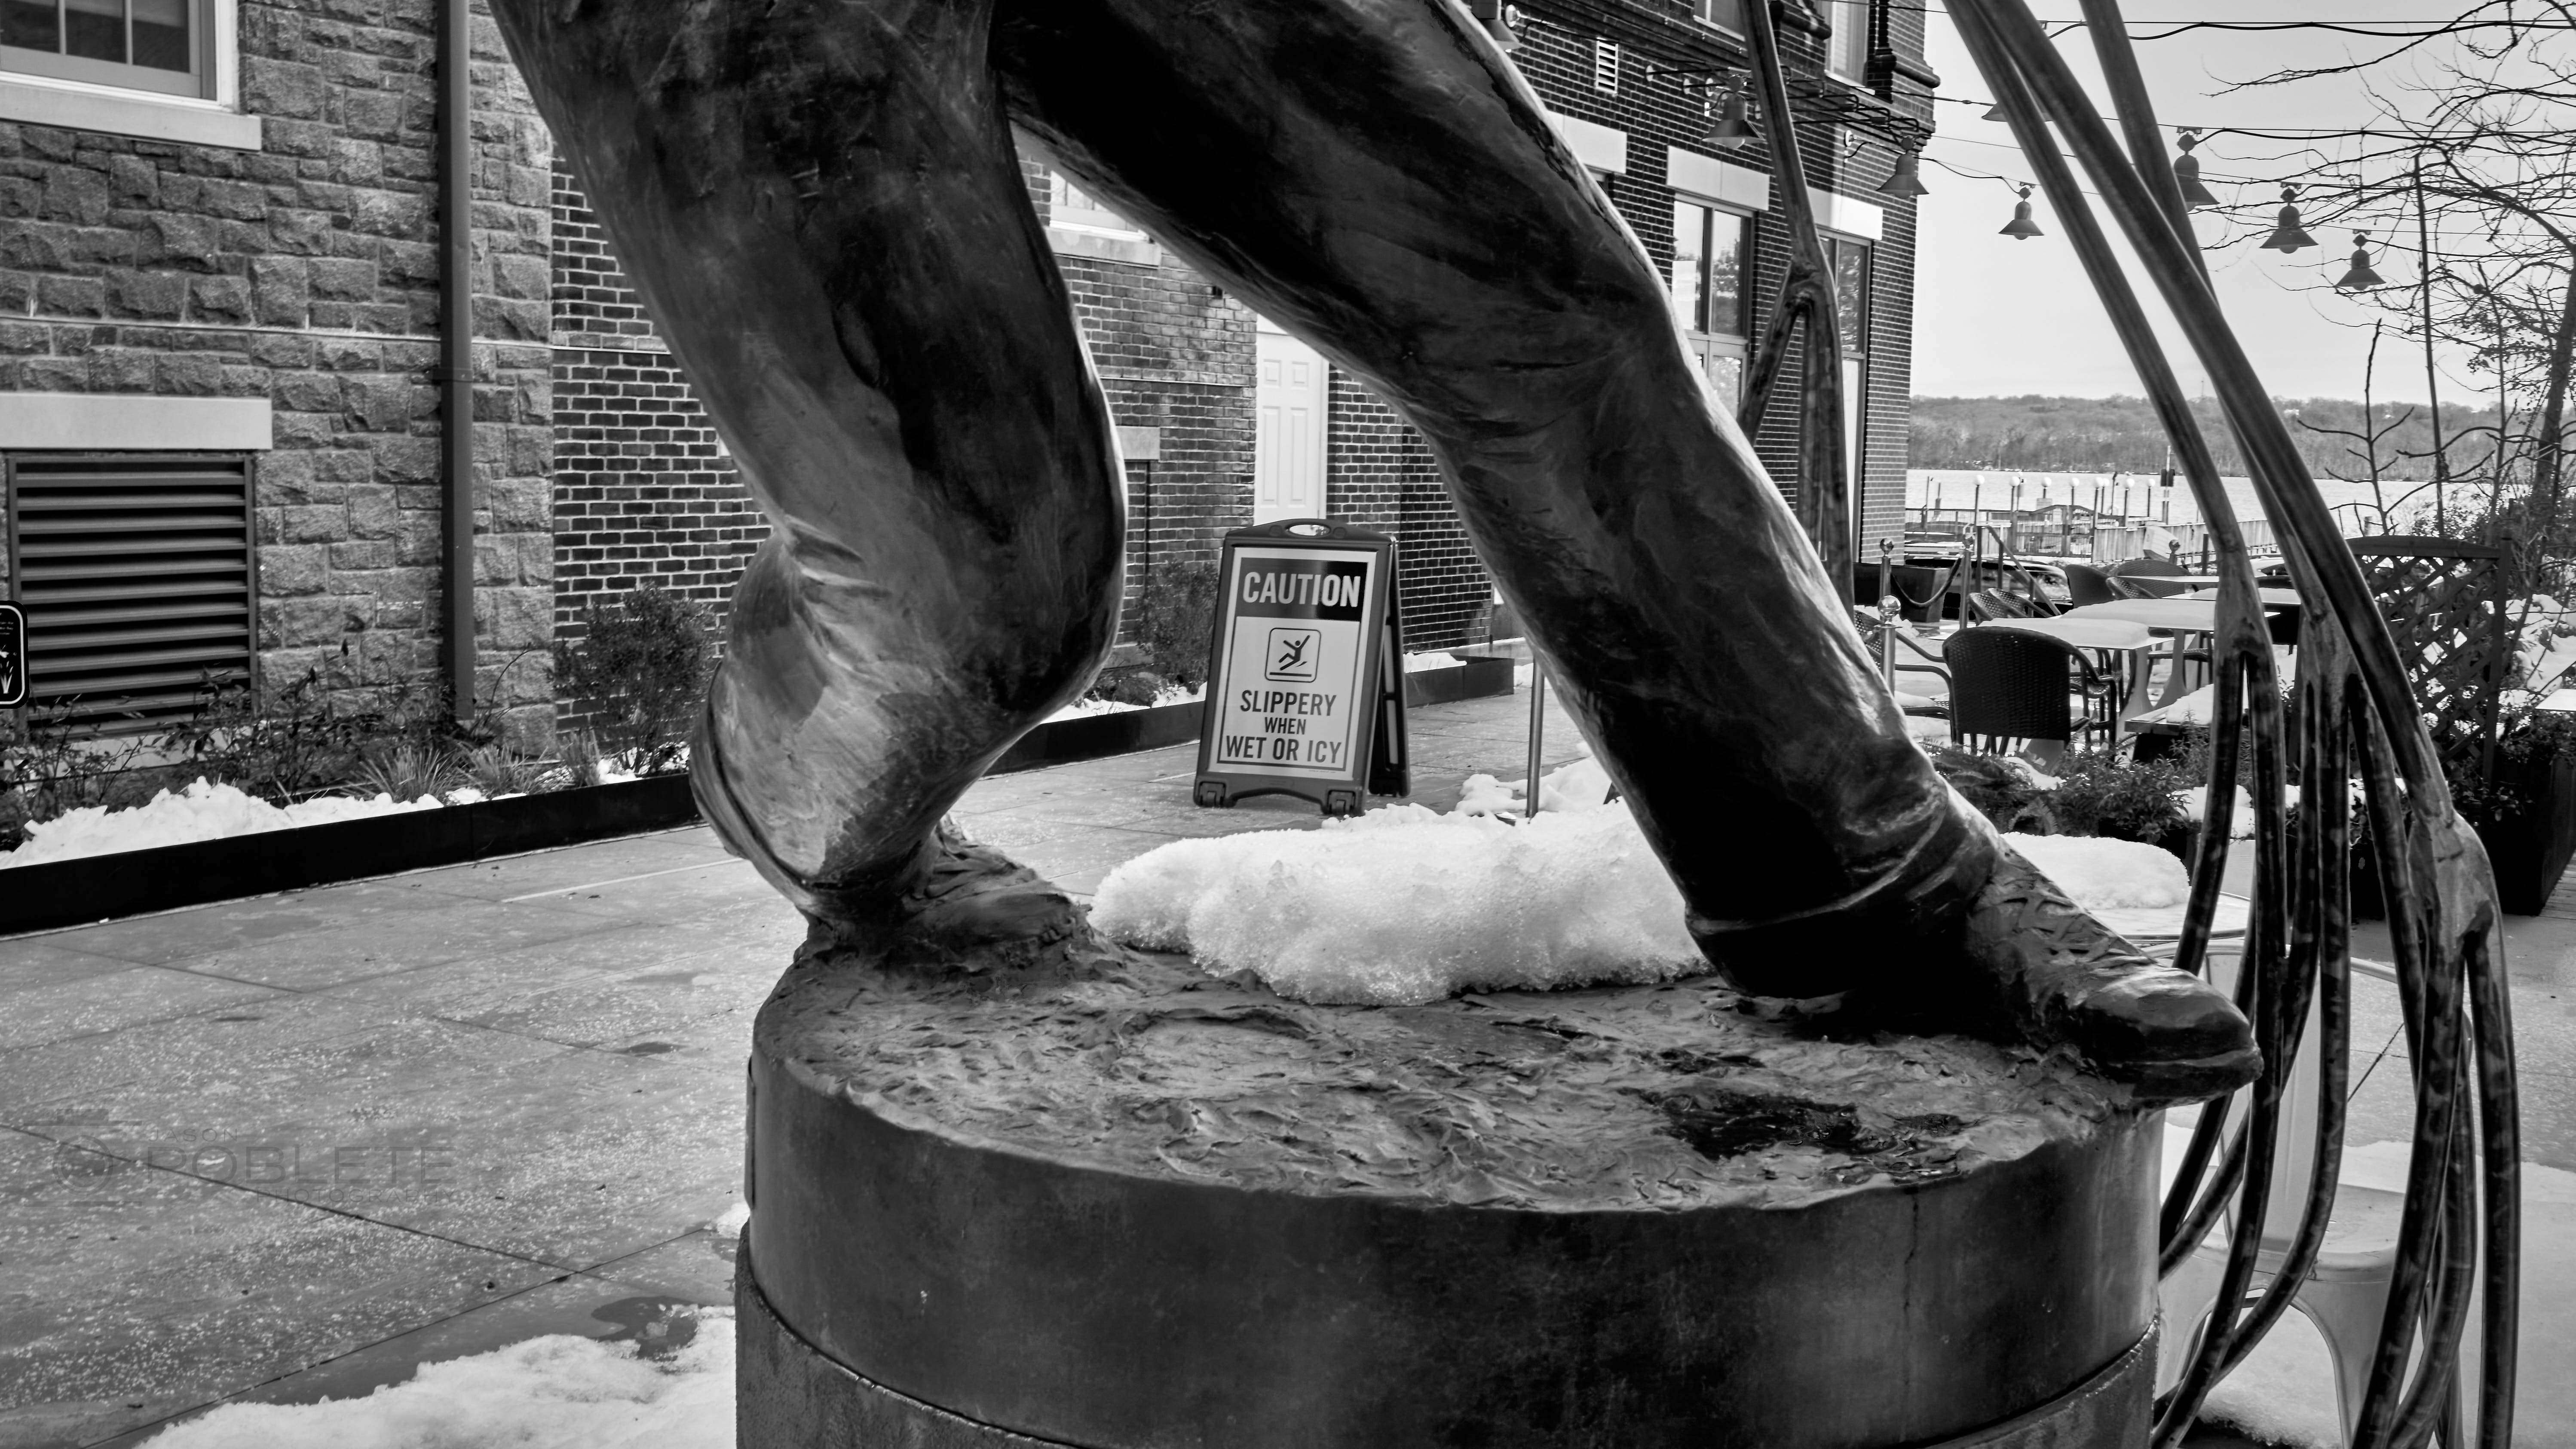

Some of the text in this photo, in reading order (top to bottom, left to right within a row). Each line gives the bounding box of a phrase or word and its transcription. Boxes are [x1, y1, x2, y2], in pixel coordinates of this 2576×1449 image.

[1243, 572, 1361, 607] CAUTION
[1240, 690, 1337, 716] SLIPPERY
[1264, 717, 1306, 735] WHEN
[1226, 735, 1342, 763] WET OR ICY
